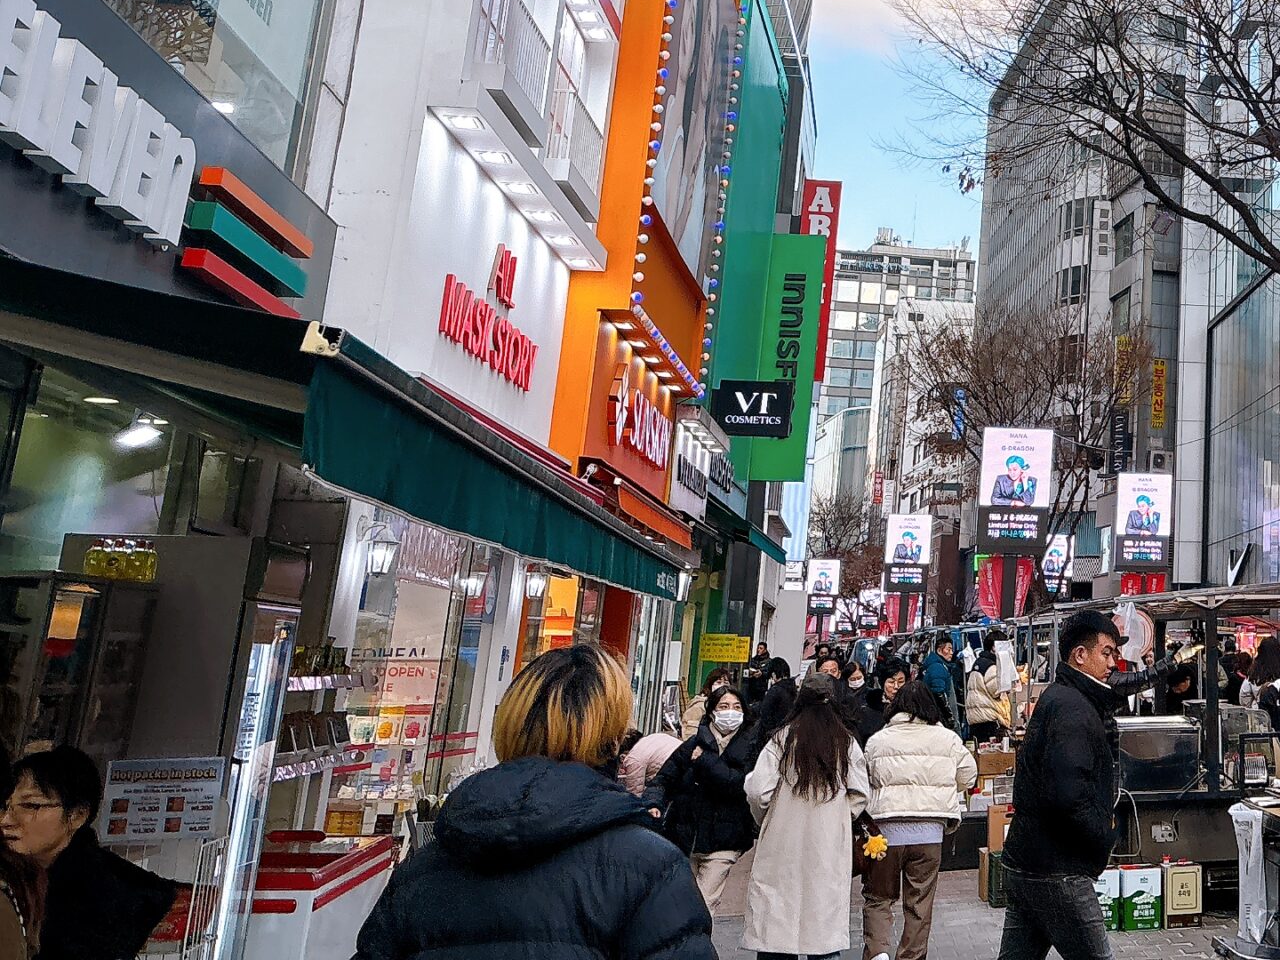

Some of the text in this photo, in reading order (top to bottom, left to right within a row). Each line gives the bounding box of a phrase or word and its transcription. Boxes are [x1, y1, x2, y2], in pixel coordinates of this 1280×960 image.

[487, 243, 517, 309] ALL
[438, 274, 539, 392] MASK STORY
[734, 391, 778, 414] VT
[725, 414, 782, 426] COSMETICS
[388, 667, 424, 677] OPEN
[111, 770, 131, 780] Hot
[132, 768, 168, 783] packs
[183, 767, 217, 779] stock
